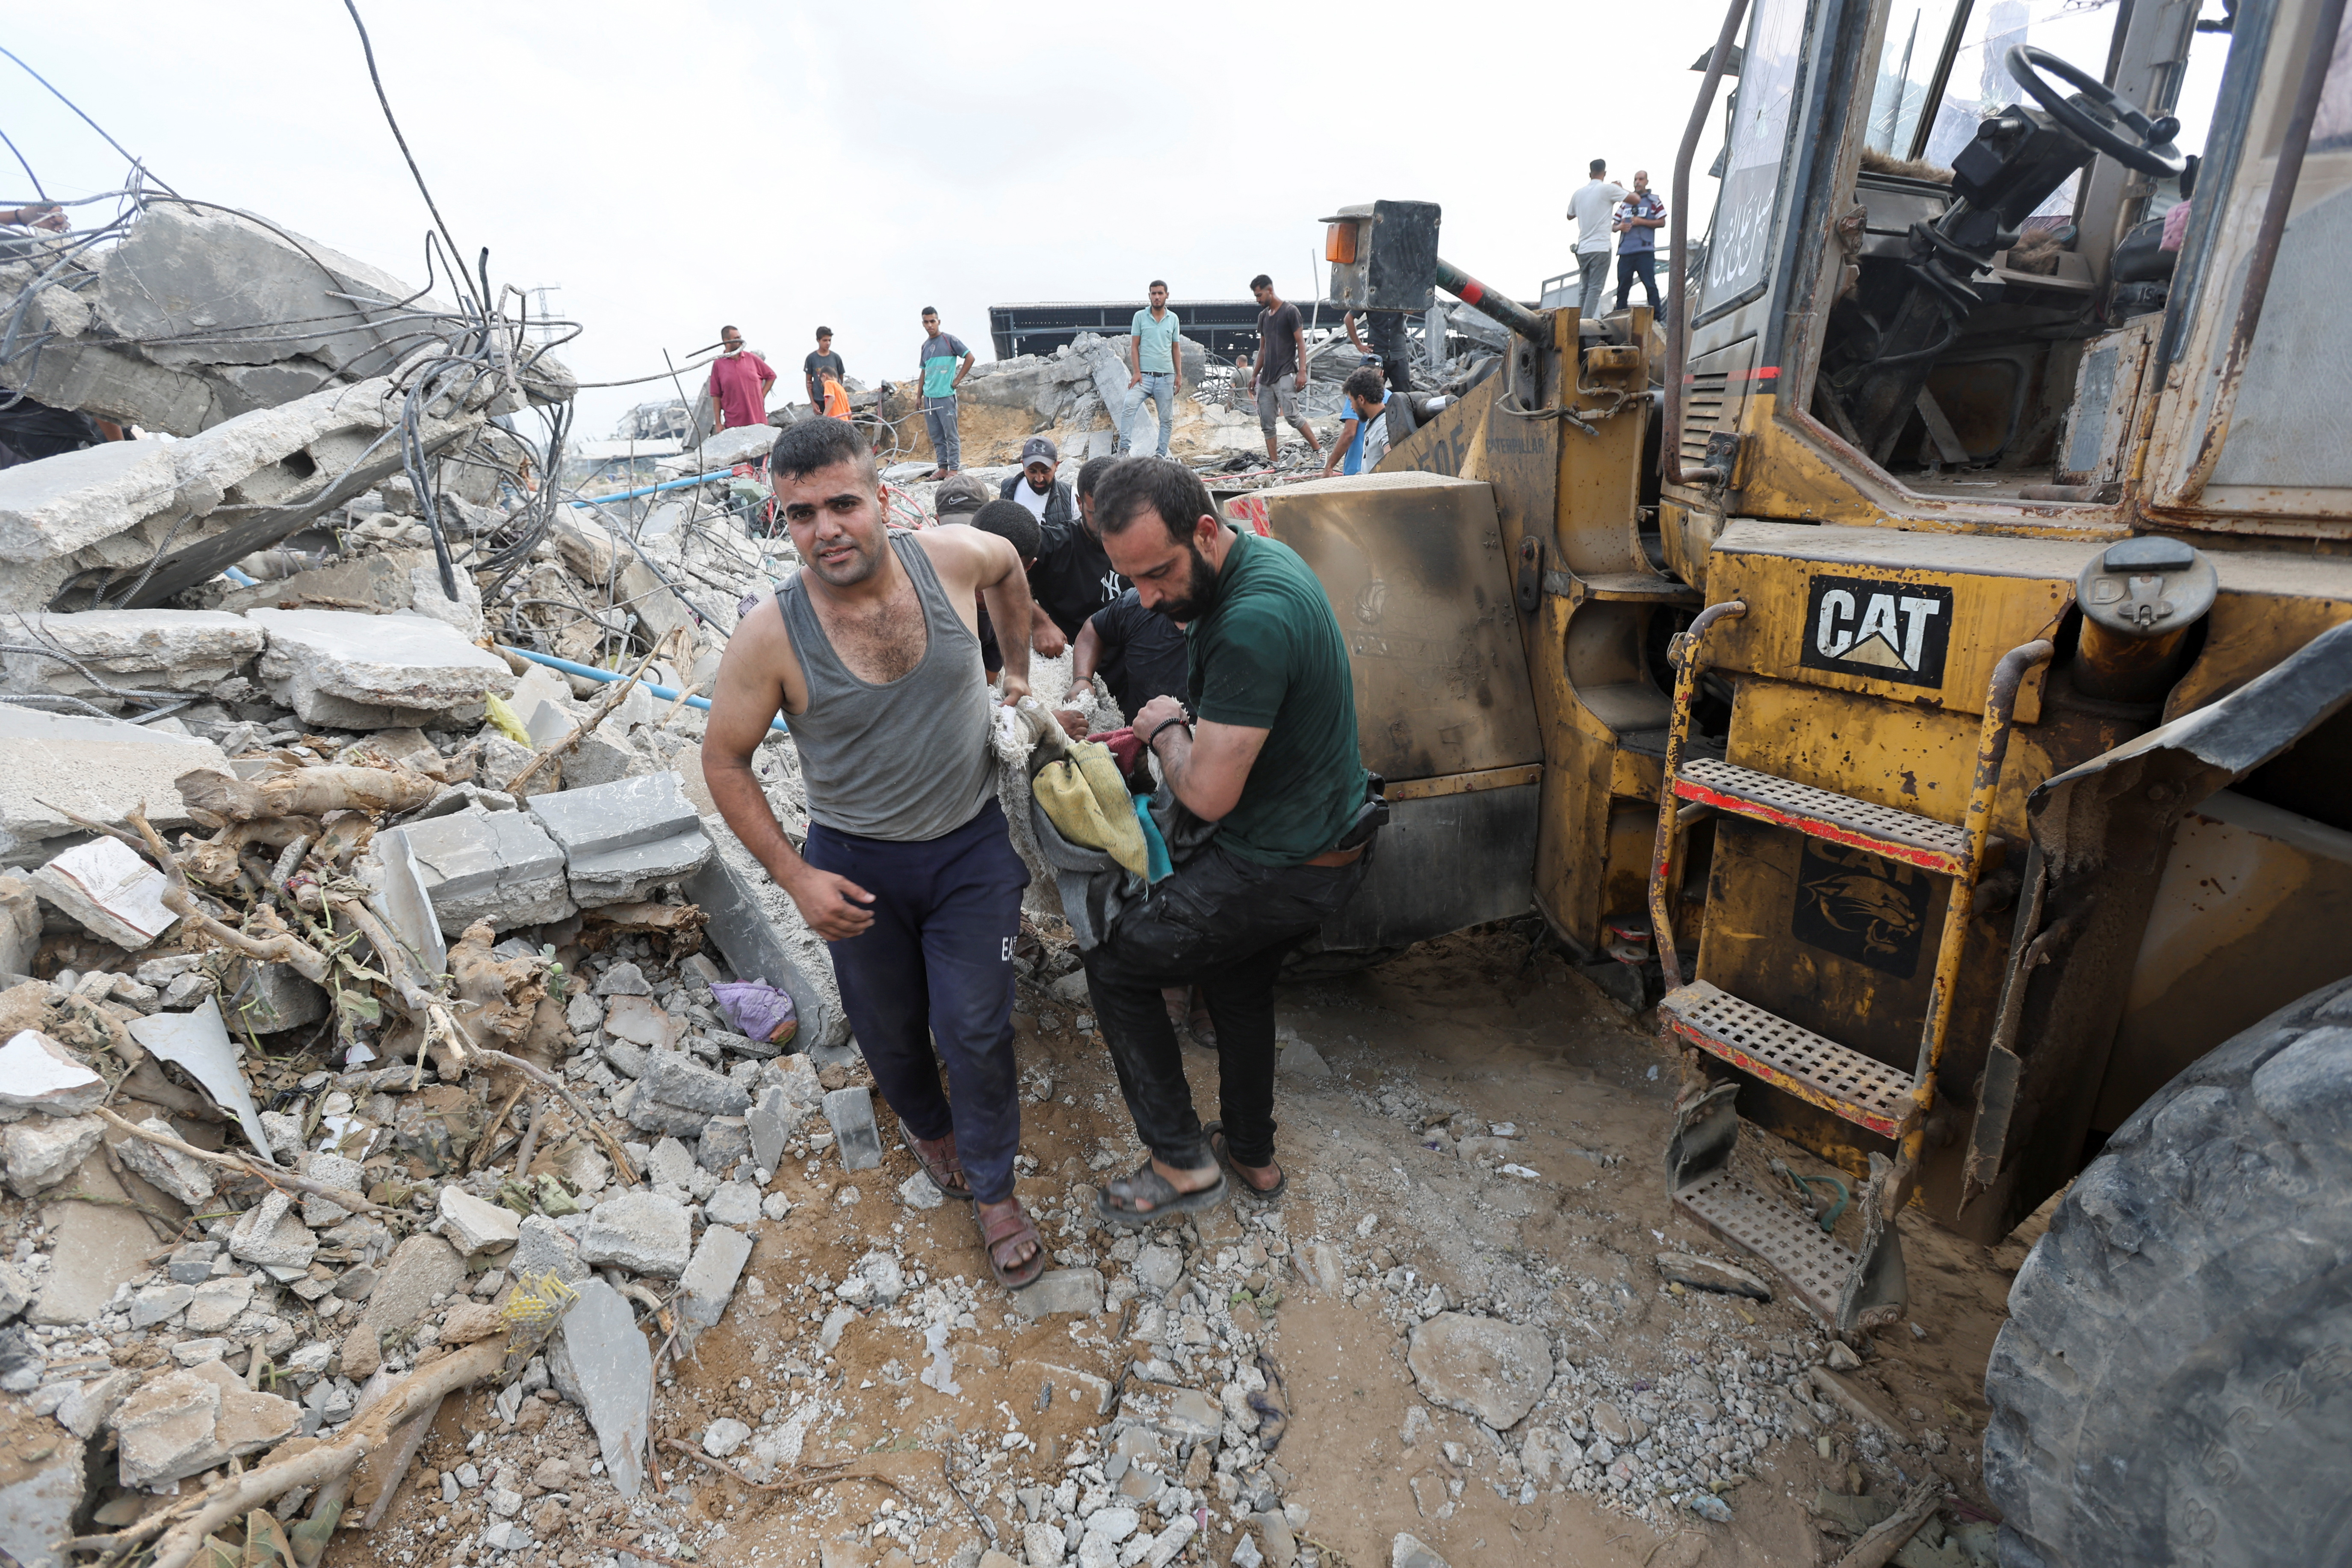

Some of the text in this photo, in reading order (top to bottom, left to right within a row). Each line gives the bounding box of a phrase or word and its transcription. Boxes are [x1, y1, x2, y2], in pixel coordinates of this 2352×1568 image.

[1486, 437, 1545, 454] CATERPILLAR
[1100, 569, 1122, 603] NY
[1817, 589, 1941, 672] CAT
